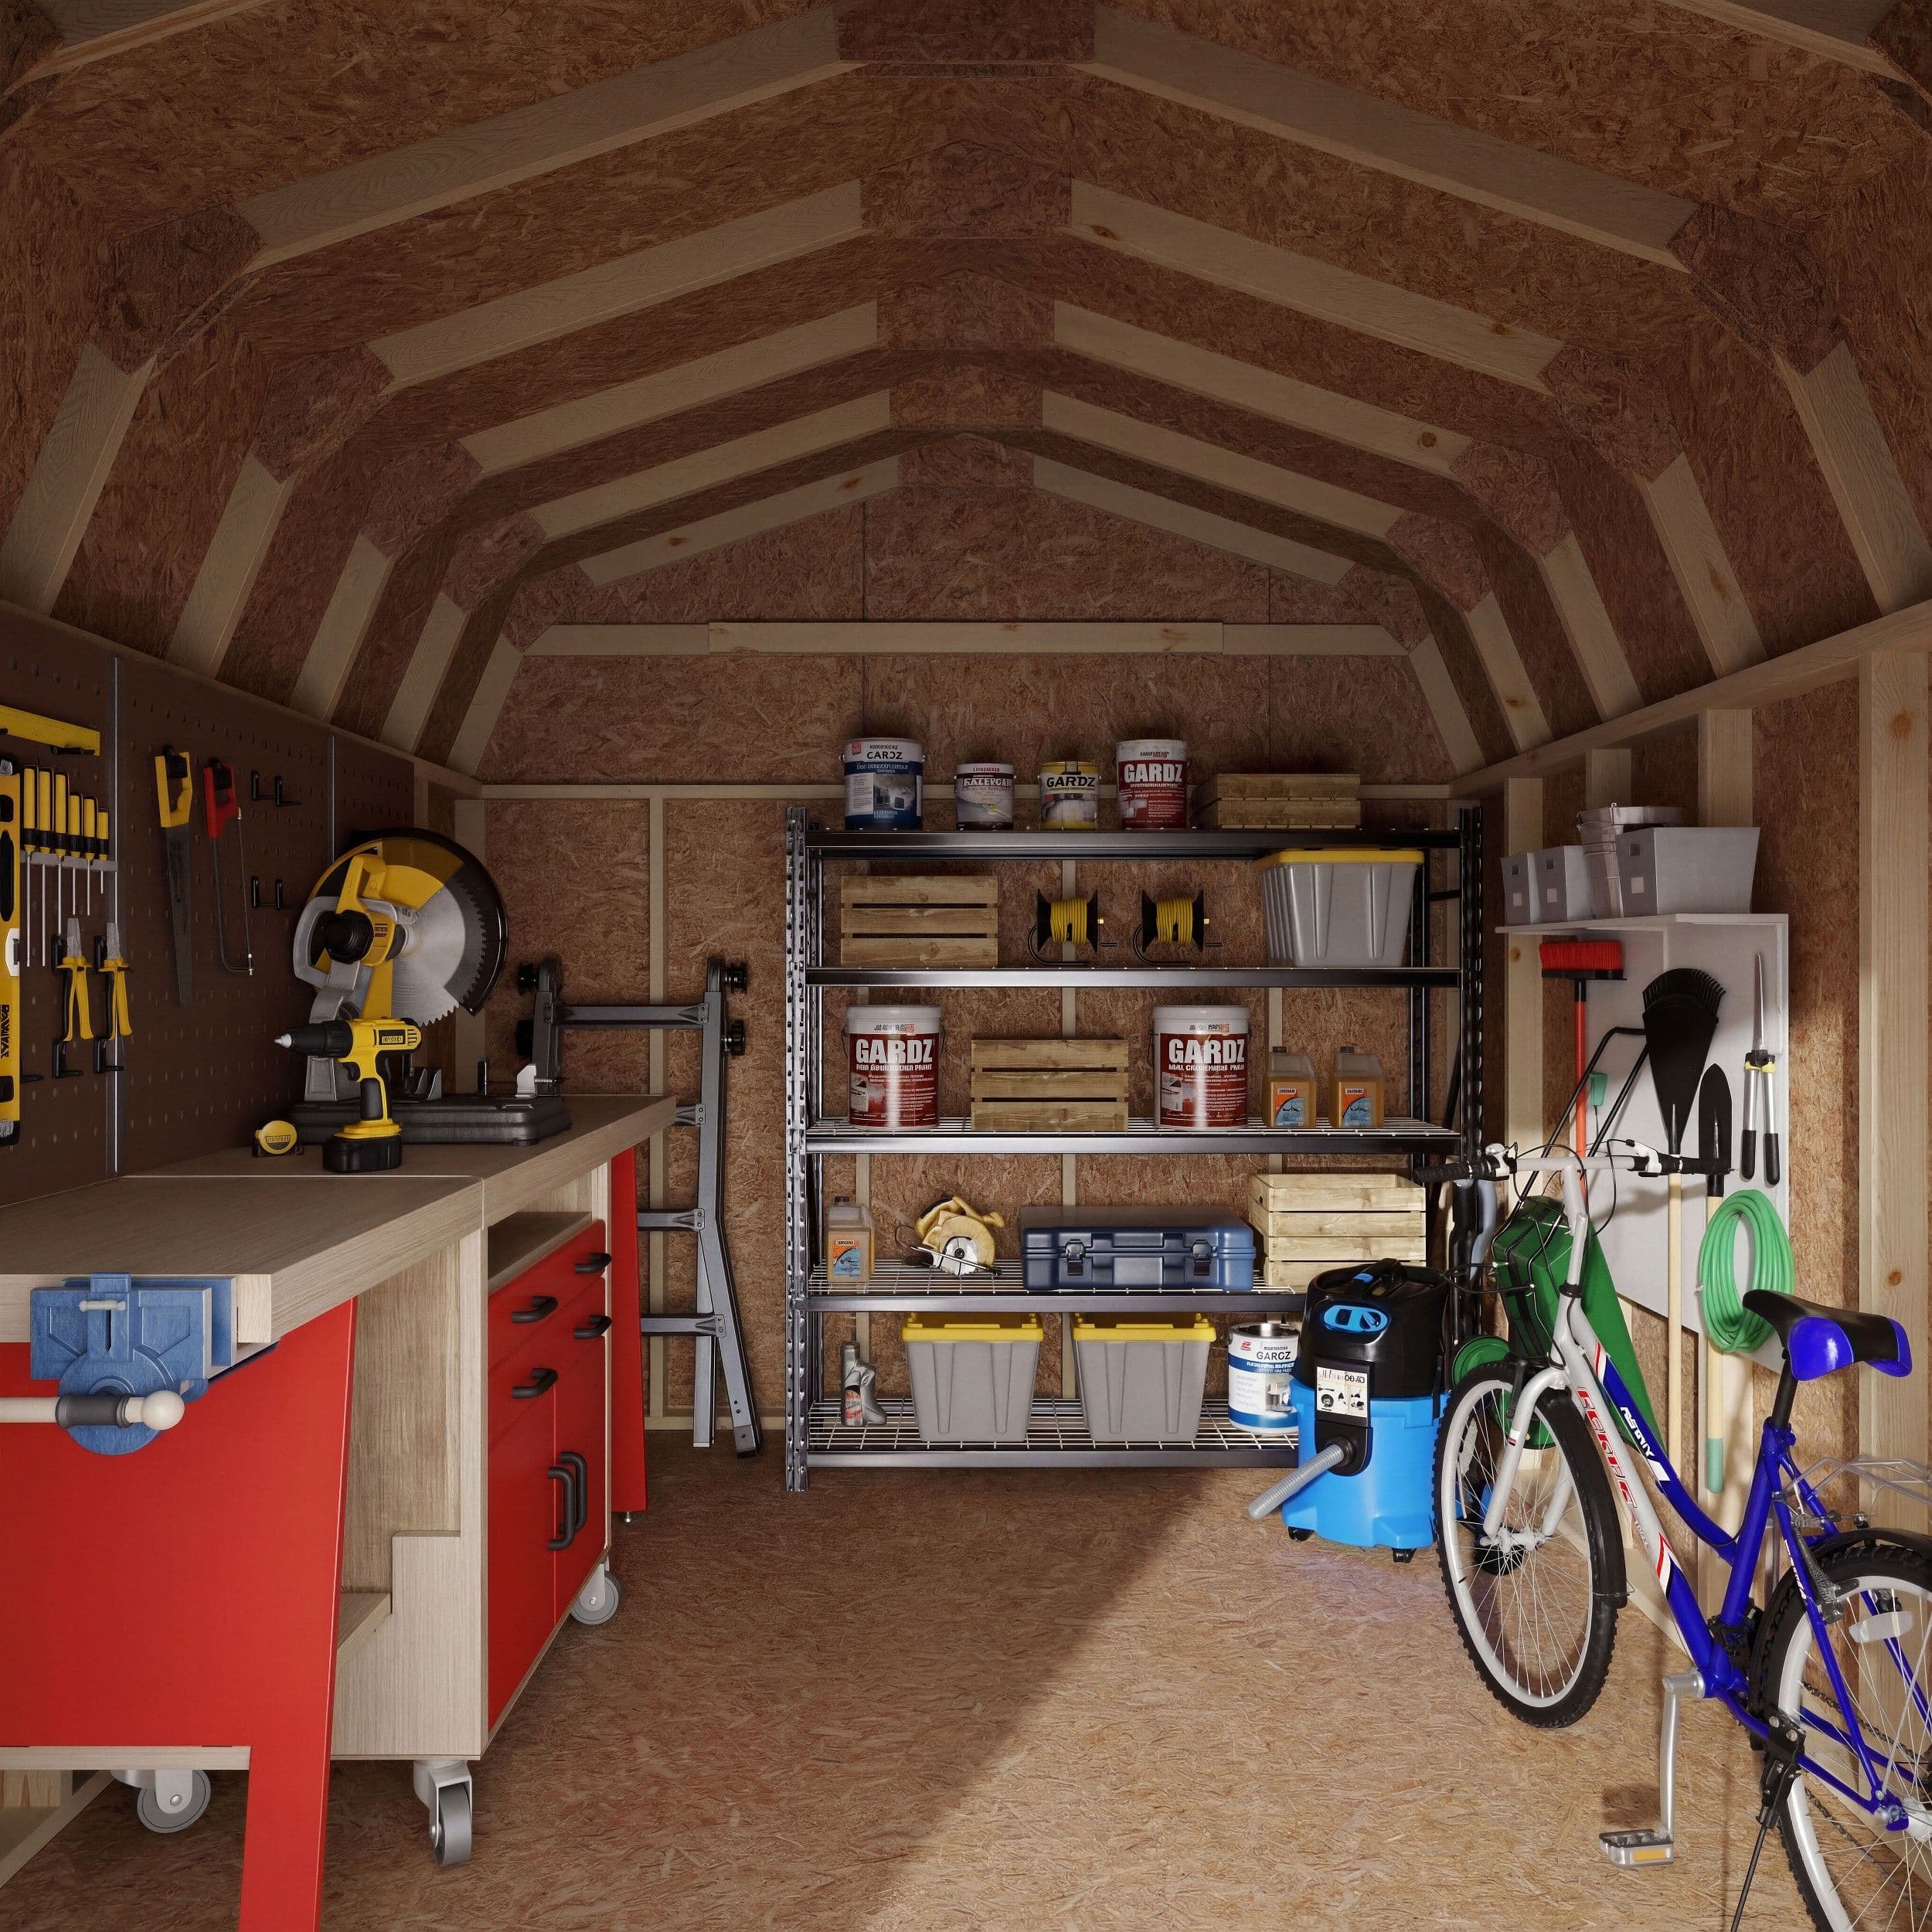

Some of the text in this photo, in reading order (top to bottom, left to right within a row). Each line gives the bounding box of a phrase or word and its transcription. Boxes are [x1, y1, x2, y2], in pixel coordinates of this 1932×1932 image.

[1046, 776, 1096, 787] GARDZ
[1124, 763, 1182, 783] GARDZ
[855, 1038, 933, 1064] GARDZ
[1168, 1038, 1245, 1064] GARDZ
